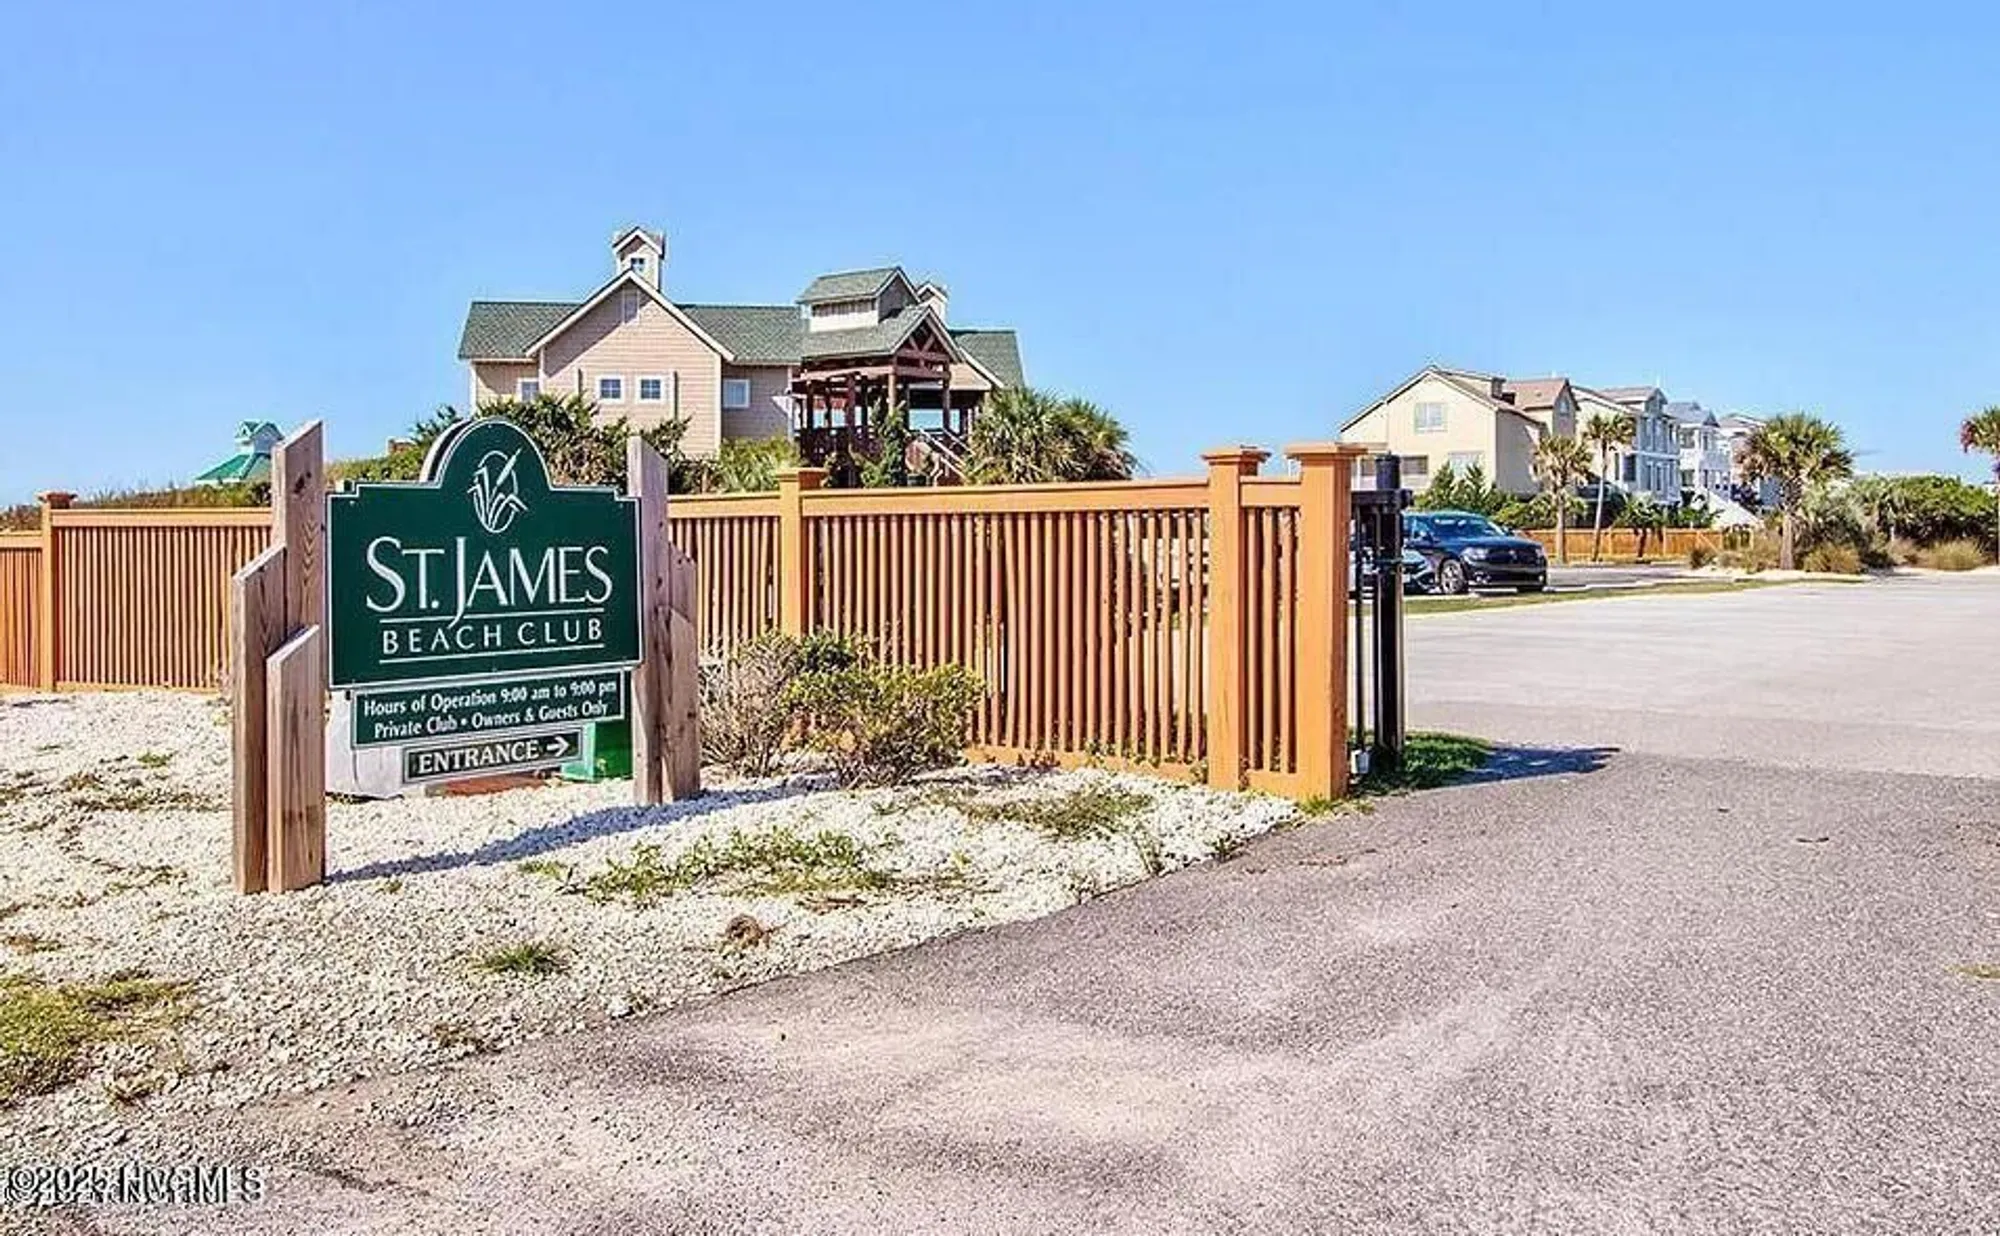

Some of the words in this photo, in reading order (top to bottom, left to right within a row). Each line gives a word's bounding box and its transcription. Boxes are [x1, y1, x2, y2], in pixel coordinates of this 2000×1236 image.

[366, 536, 445, 613] ST.
[448, 536, 613, 629] JAMES
[382, 625, 501, 654] BEACH
[517, 618, 603, 645] CLUB
[364, 699, 407, 717] Hours
[411, 694, 426, 712] of
[430, 689, 497, 713] Operation
[500, 686, 527, 703] 9:00
[530, 688, 550, 700] am
[553, 684, 567, 698] to
[570, 680, 596, 696] 9:00
[599, 681, 617, 697] pm
[374, 720, 422, 739] Private
[427, 714, 457, 734] Club
[471, 711, 521, 729] Owners
[524, 707, 535, 722] &
[538, 705, 578, 721] Guests
[582, 700, 609, 717] Only
[417, 740, 540, 774] ENTRANCE
